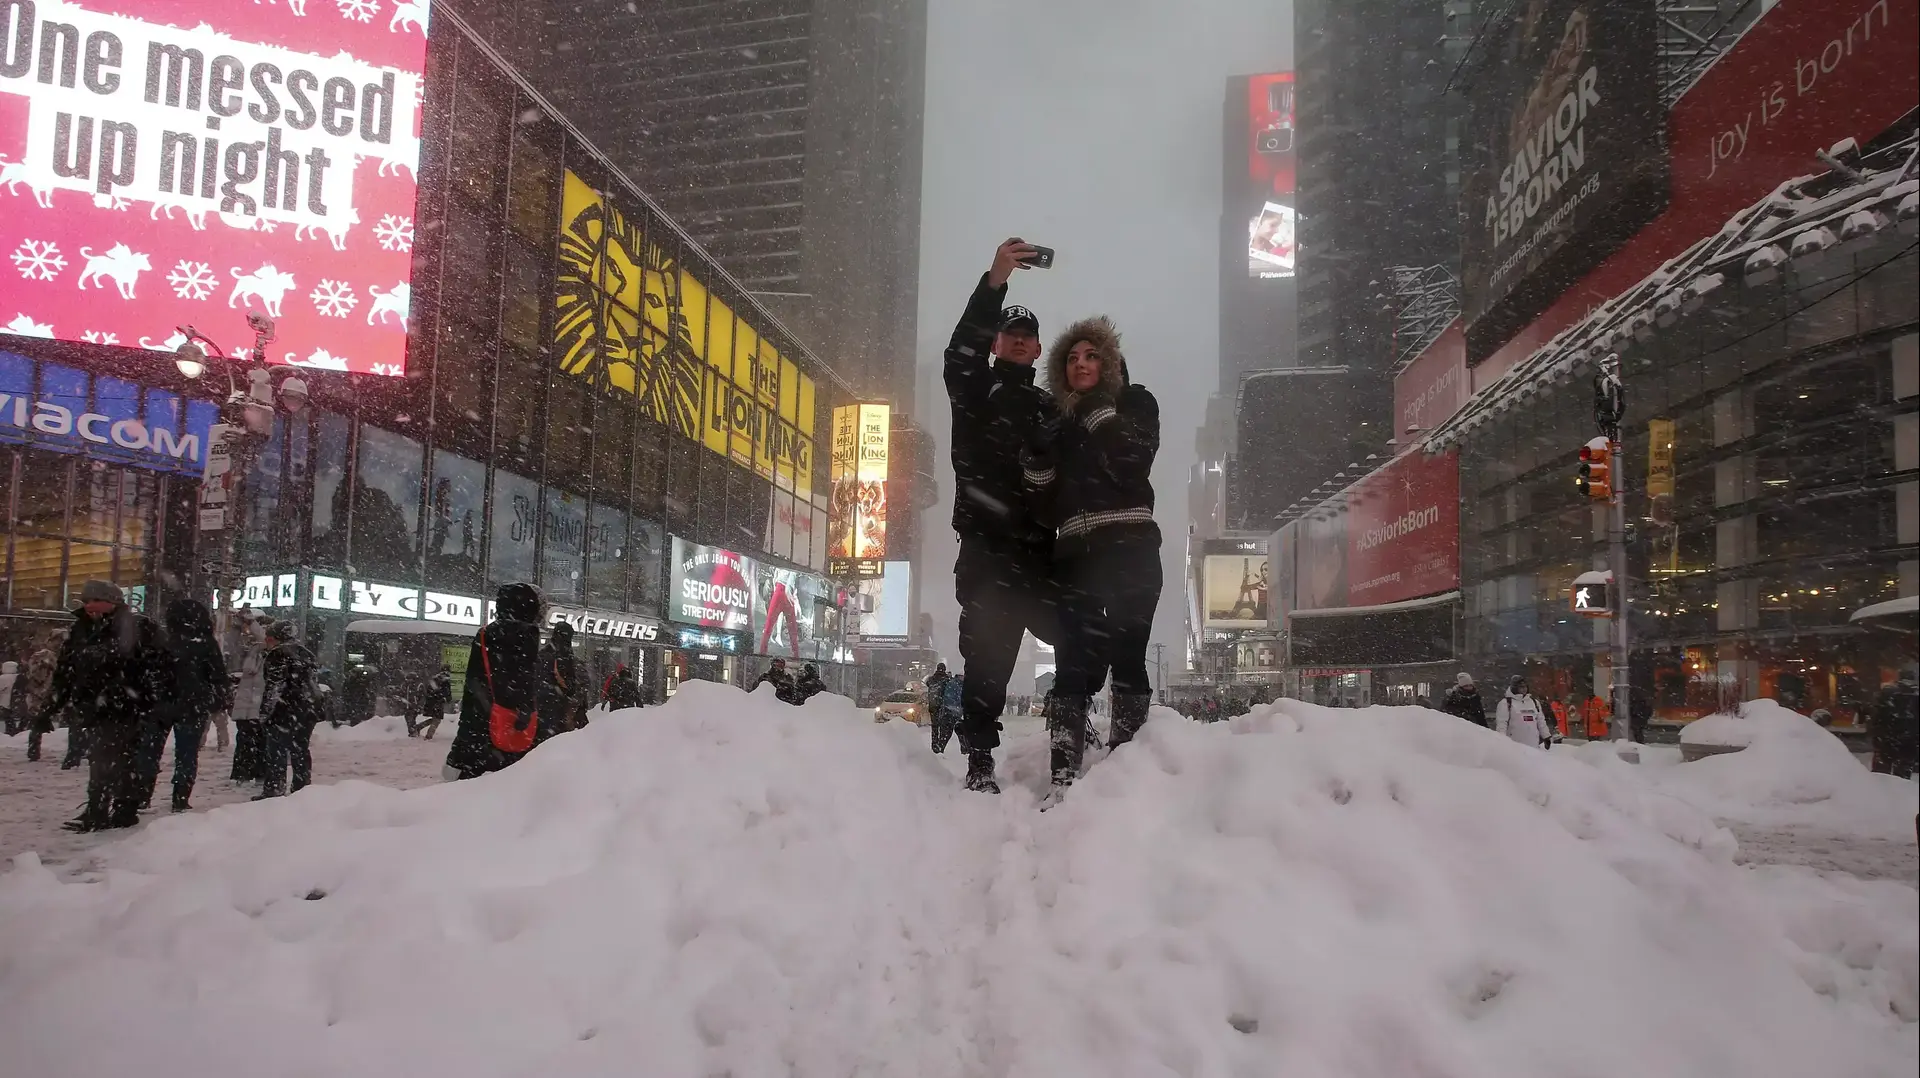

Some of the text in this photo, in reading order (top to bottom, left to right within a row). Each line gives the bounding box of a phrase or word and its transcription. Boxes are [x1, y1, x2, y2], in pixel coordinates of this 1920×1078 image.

[0, 0, 395, 144] One messed
[1706, 0, 1888, 180] Joy is born
[53, 112, 331, 216] up night
[1485, 65, 1601, 228] A SAVIOR
[1489, 171, 1600, 288] christmas.mormon.org
[1006, 306, 1032, 320] FBI
[748, 353, 776, 398] THE
[1404, 363, 1459, 424] Hope is born
[712, 364, 807, 470] LION KING
[863, 433, 883, 444] LION
[861, 446, 886, 460] KING
[682, 558, 694, 573] THE
[695, 553, 709, 565] ONLY
[711, 553, 728, 565] JEAN
[682, 578, 749, 609] SERIOUSLY
[682, 604, 725, 621] STRETCHY
[547, 612, 658, 641] SKECHERS
